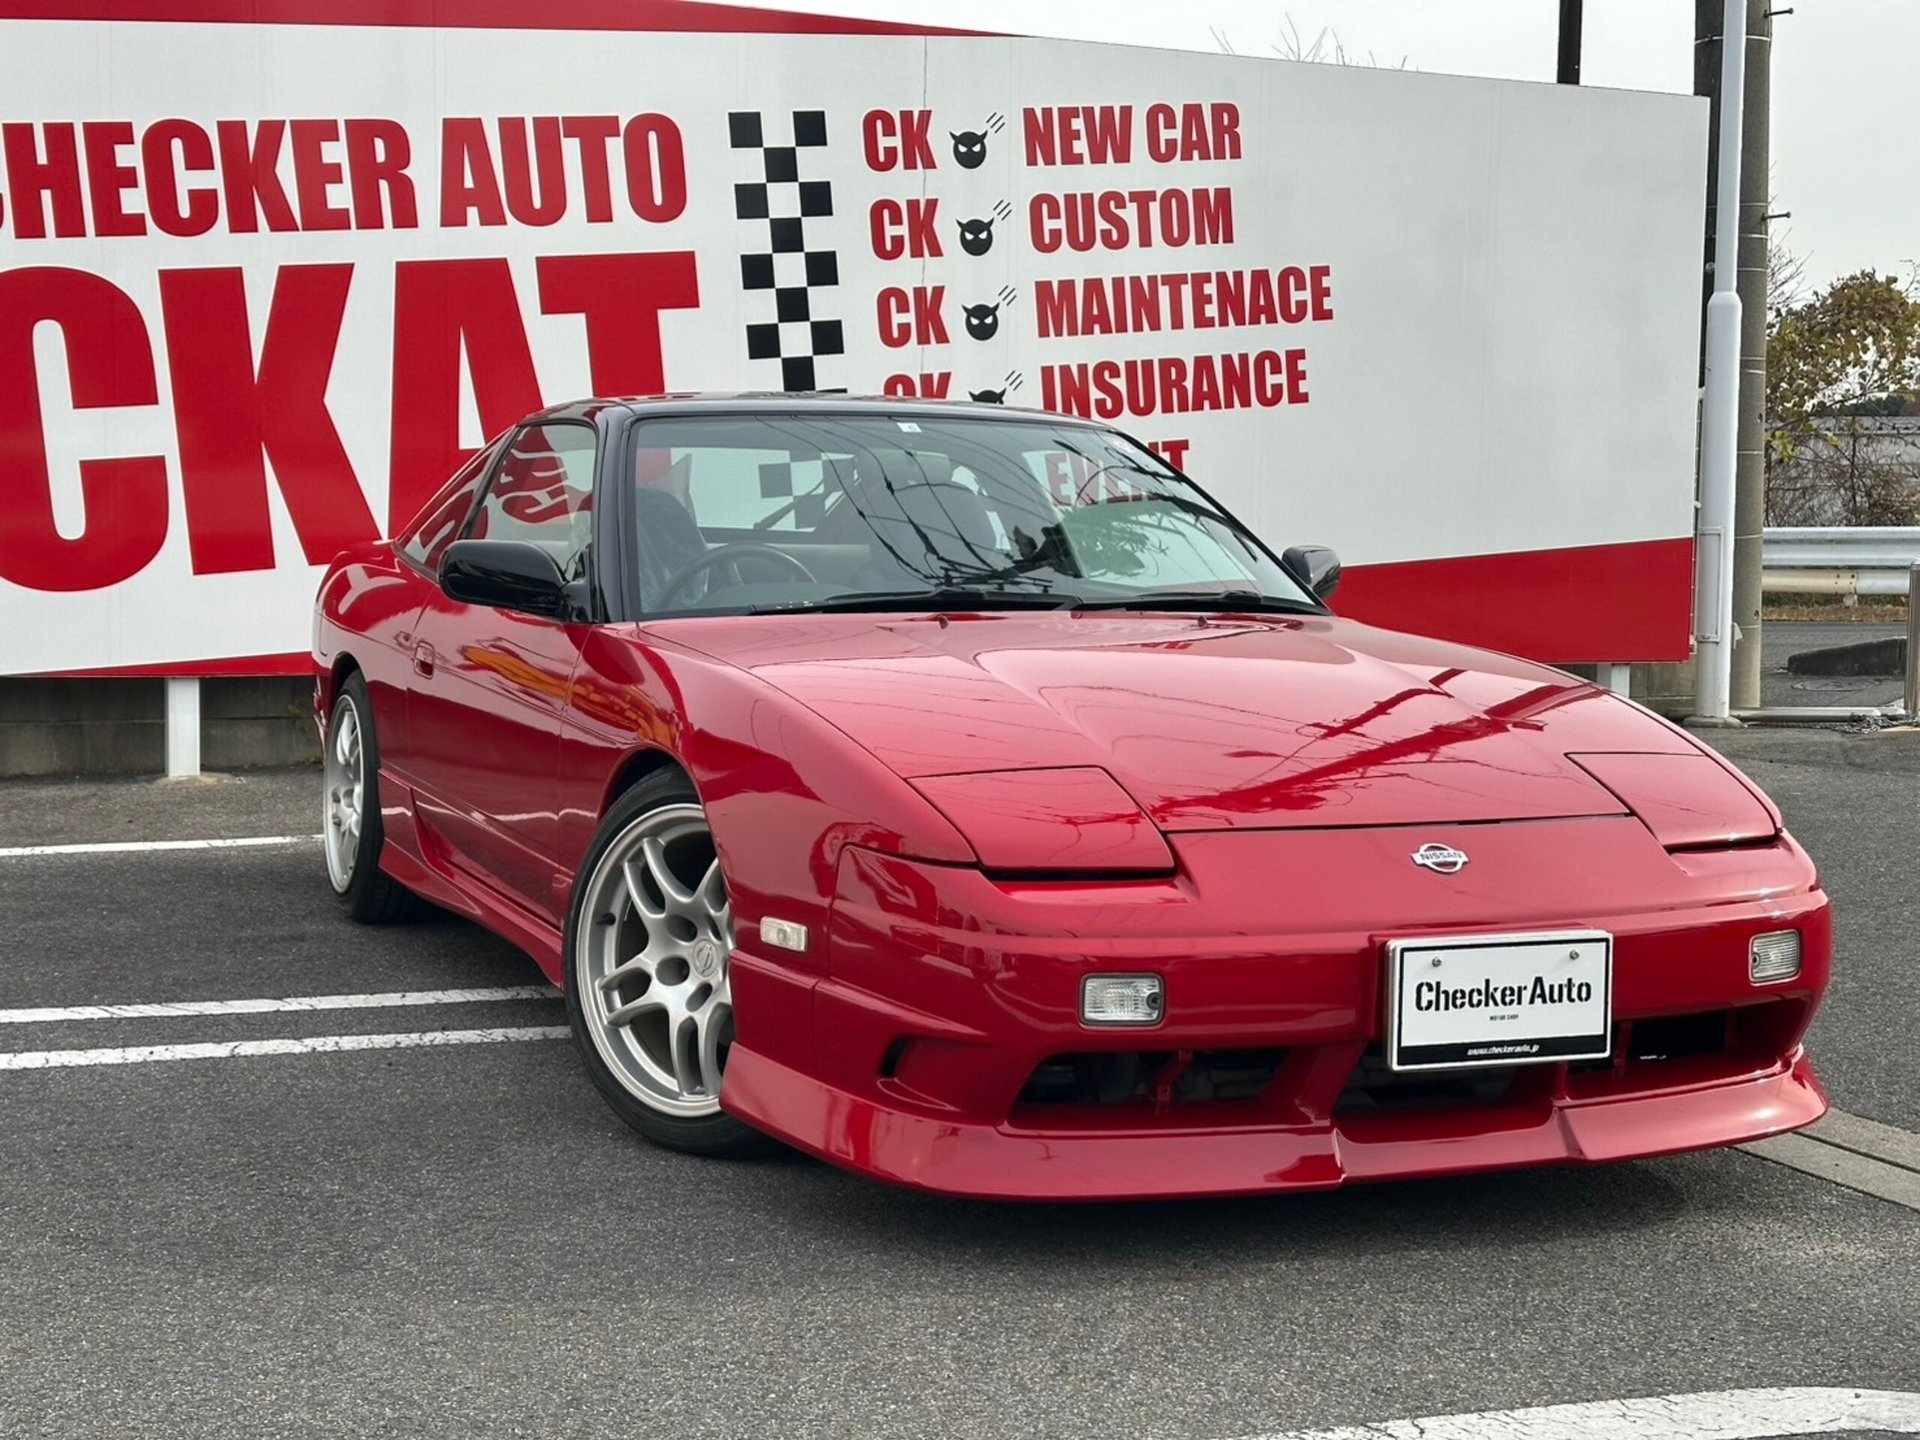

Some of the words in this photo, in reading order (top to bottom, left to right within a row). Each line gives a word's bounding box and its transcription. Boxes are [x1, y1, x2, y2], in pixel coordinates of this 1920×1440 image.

[864, 110, 937, 172] CK
[1025, 106, 1133, 166] NEW
[1147, 104, 1241, 162] CAR
[0, 117, 419, 240] HECKER
[441, 113, 688, 228] AUTO
[871, 199, 944, 260] CK
[1029, 188, 1234, 253] CUSTOM
[877, 286, 950, 348] CK
[1035, 267, 1333, 338] MAINTENACE
[1041, 348, 1309, 420] INSURANCE
[1415, 975, 1592, 1012] CheckerAuto
